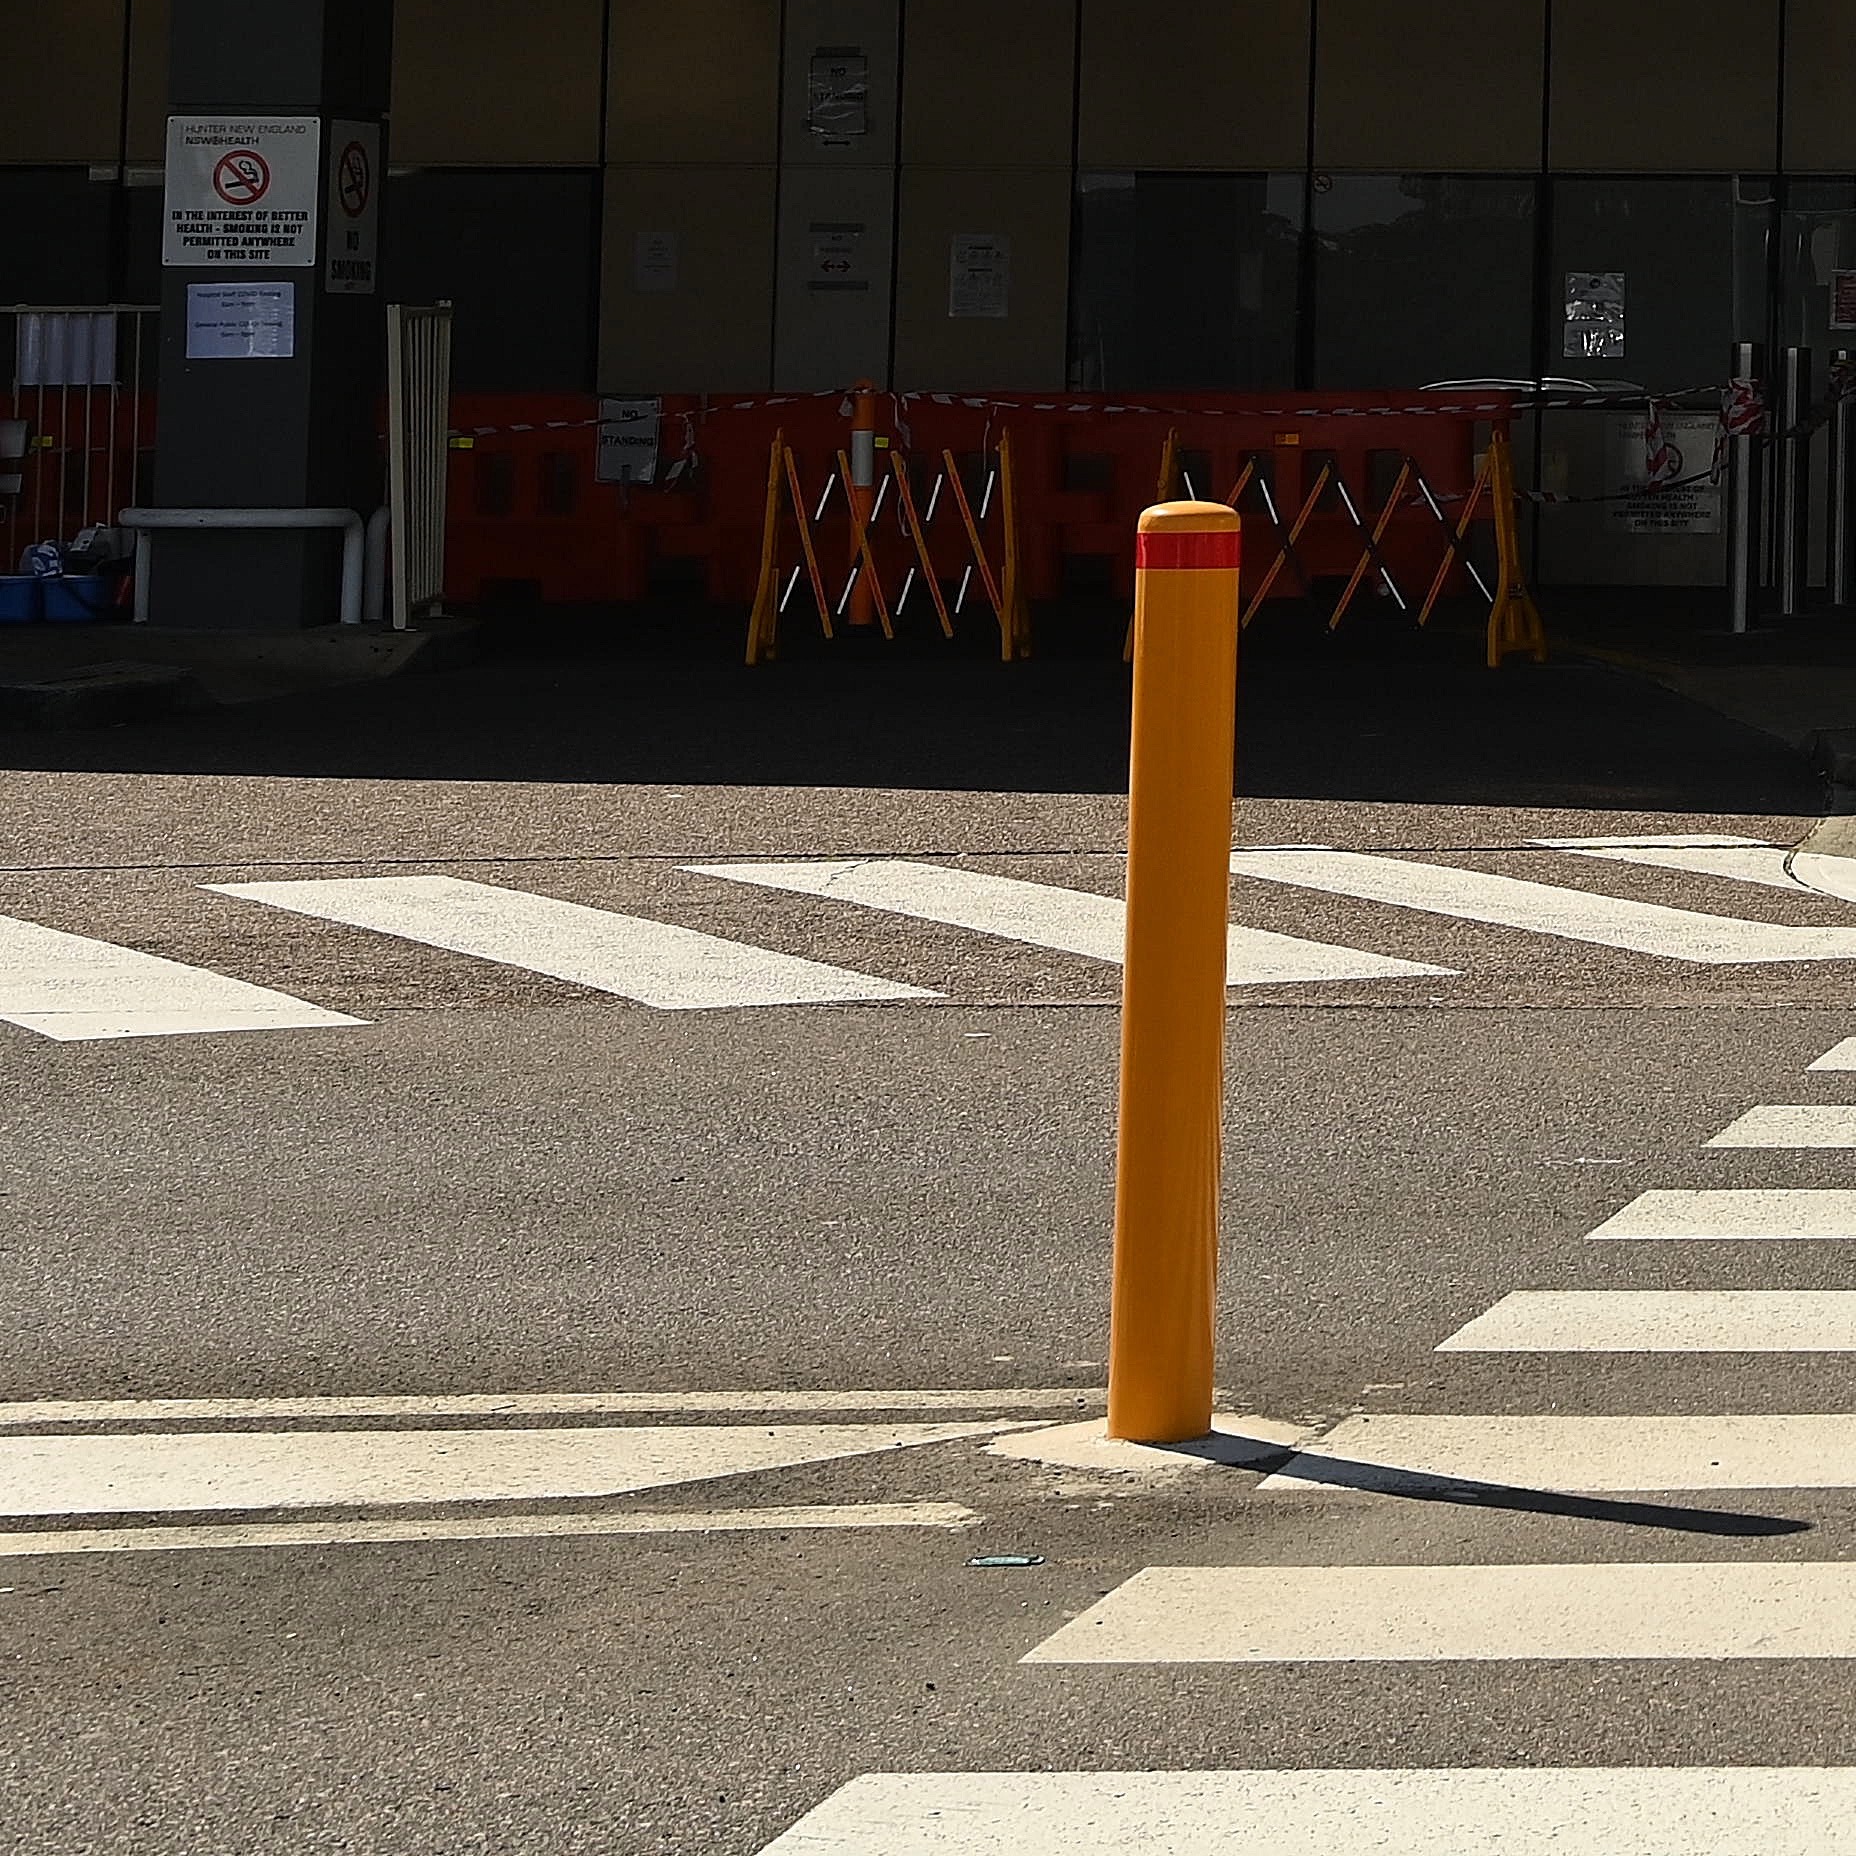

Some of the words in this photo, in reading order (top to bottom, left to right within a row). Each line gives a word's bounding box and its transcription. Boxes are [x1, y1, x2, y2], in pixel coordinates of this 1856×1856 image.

[172, 211, 183, 221] IN
[185, 211, 204, 221] THE
[206, 211, 252, 221] INTEREST
[255, 211, 268, 221] OF
[271, 211, 308, 221] BETTER
[176, 224, 213, 234] HEALTH
[222, 224, 268, 234] SMOKING
[270, 224, 280, 234] IS
[283, 224, 302, 234] NOT
[183, 236, 239, 247] PERMITTED
[241, 236, 295, 247] ANYWHERE
[207, 250, 221, 260] ON
[224, 250, 246, 260] THIS
[248, 250, 270, 260] SITE
[622, 410, 638, 418] NO
